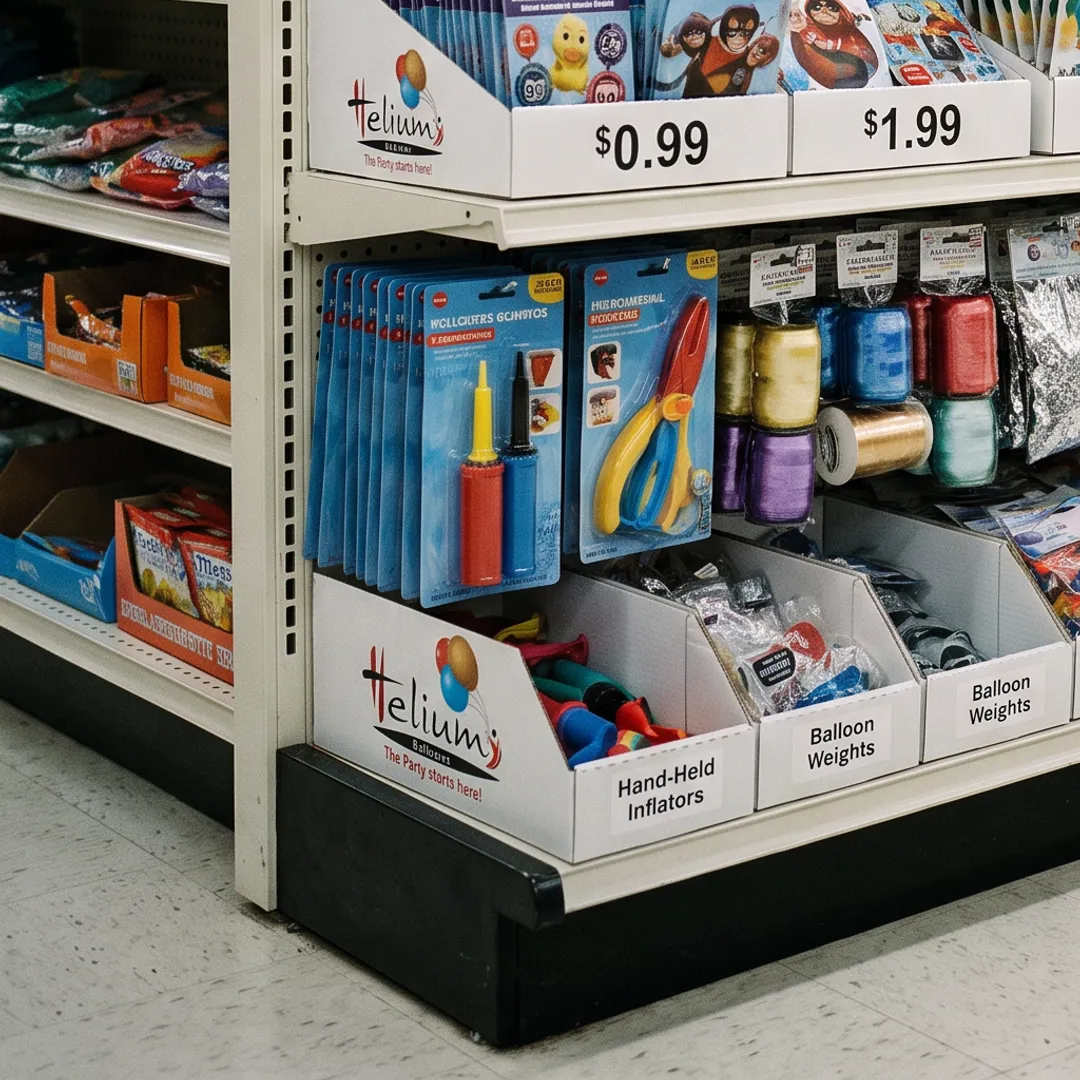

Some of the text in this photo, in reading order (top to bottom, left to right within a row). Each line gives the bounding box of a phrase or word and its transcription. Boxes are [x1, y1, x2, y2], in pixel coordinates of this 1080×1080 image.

[347, 77, 436, 140] Helium
[863, 103, 962, 151] $1.99
[595, 120, 709, 171] $0.99
[362, 645, 490, 758] Helium
[972, 676, 1031, 701] Balloon
[810, 719, 875, 745] Balloon
[969, 698, 1031, 725] Weights
[384, 745, 482, 802] The Party starts here!
[807, 742, 875, 770] Weights
[618, 757, 715, 798] Hand-Held
[628, 789, 704, 821] Inflators
